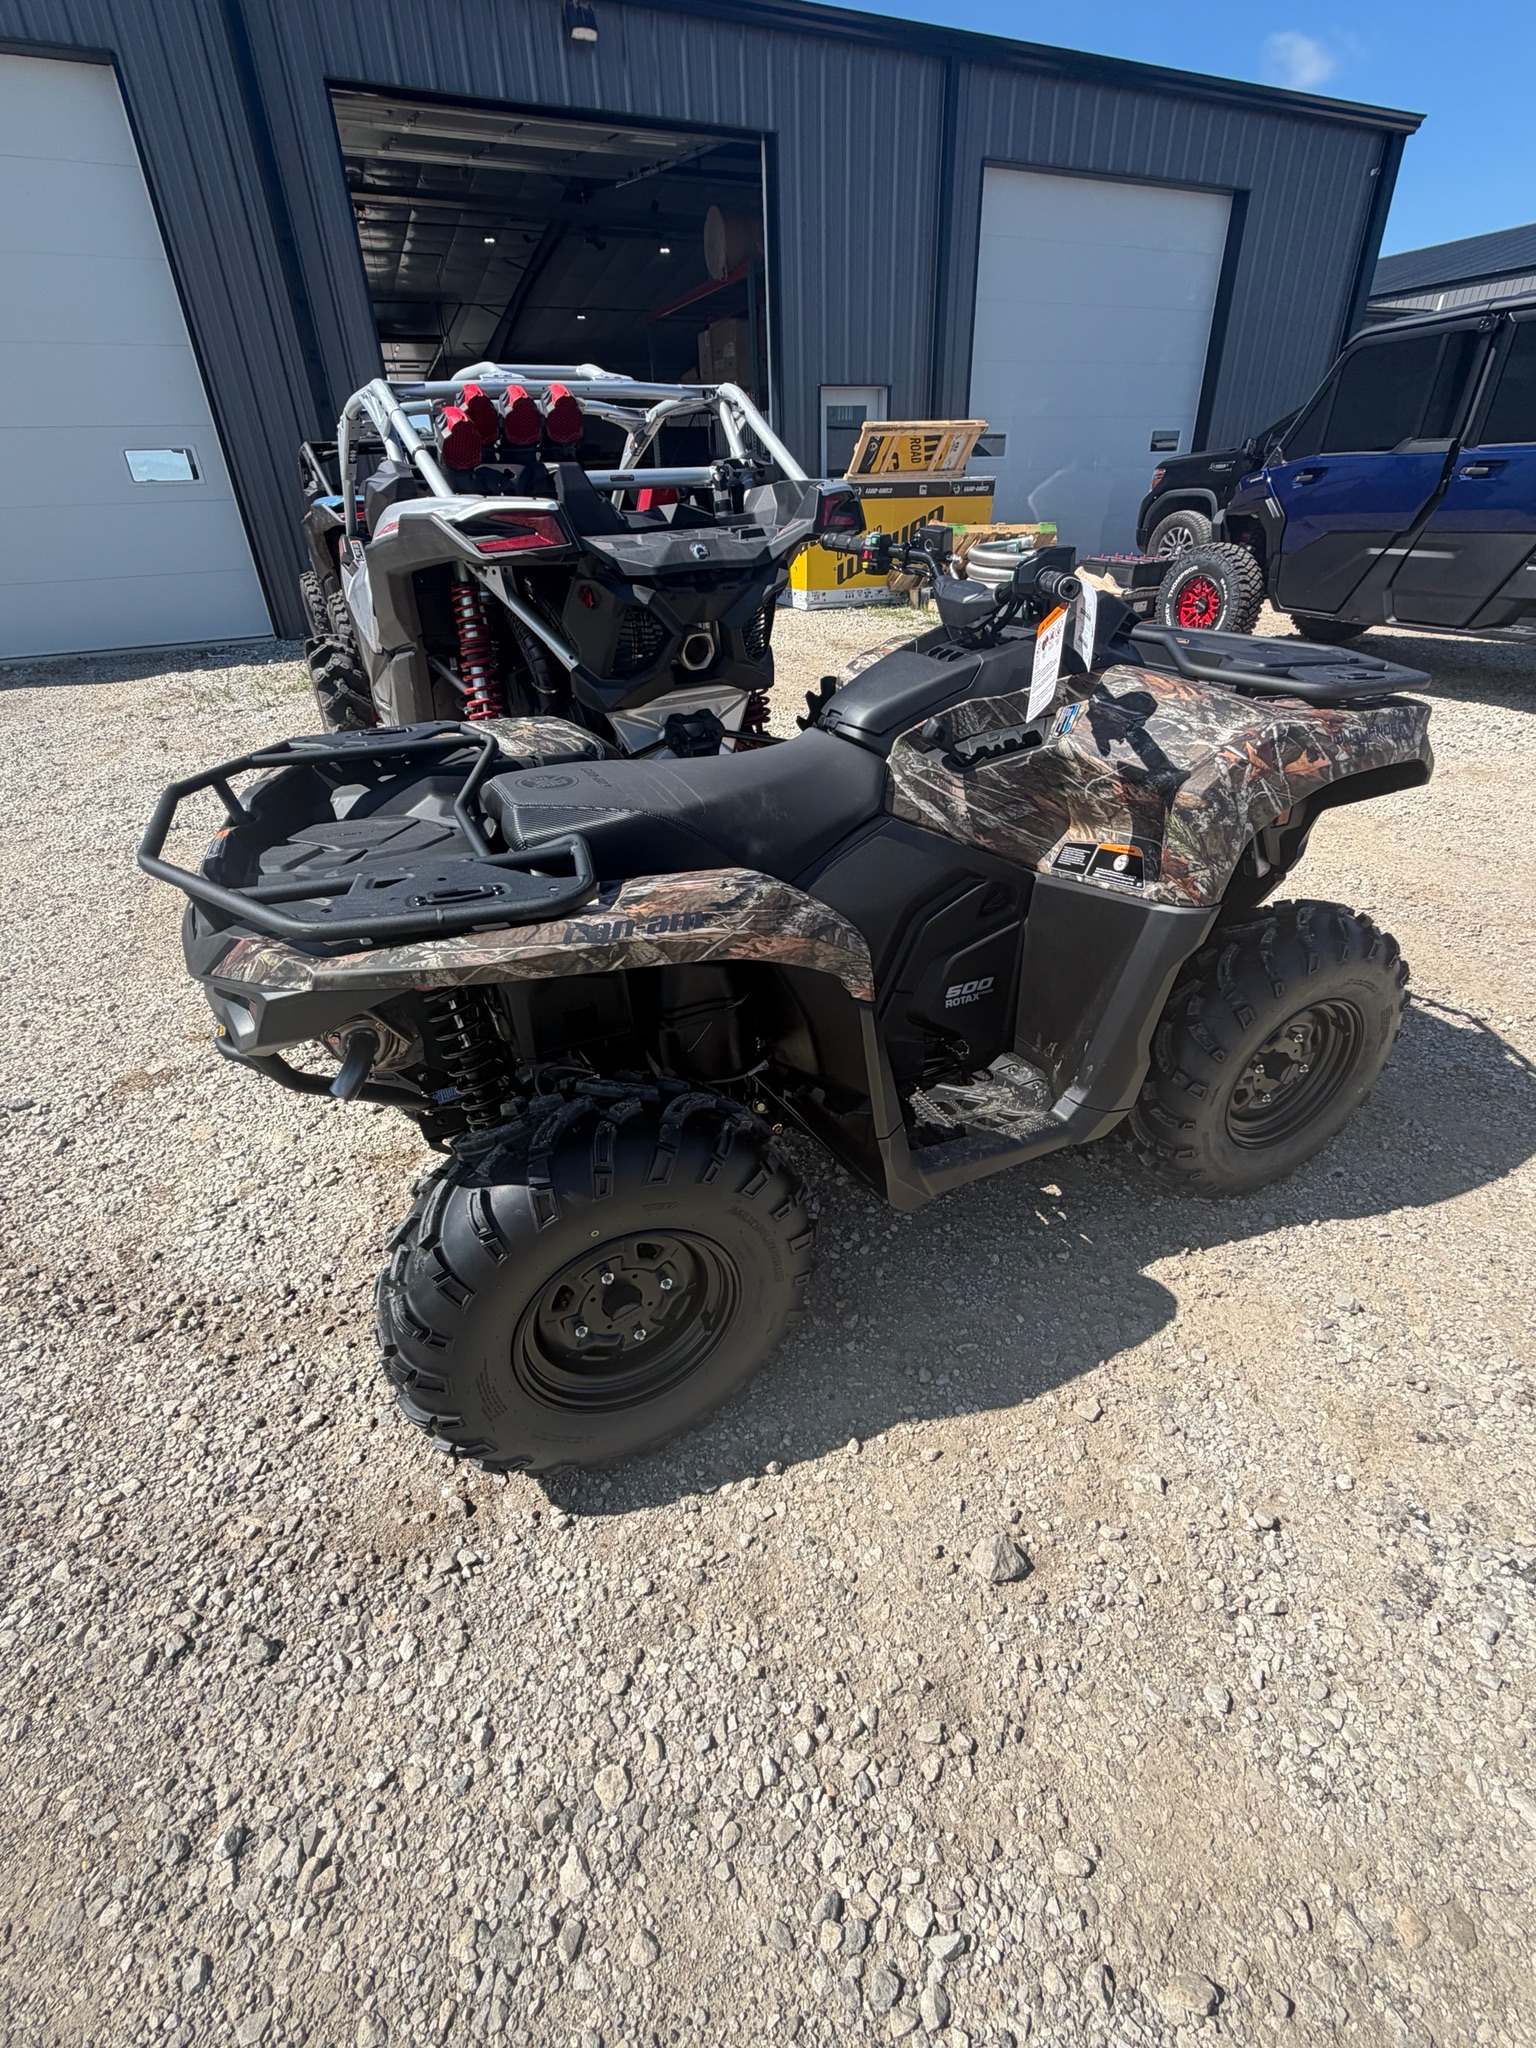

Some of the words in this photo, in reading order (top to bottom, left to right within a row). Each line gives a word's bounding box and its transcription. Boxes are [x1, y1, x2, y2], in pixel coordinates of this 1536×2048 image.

[1167, 565, 1199, 598] THOMPSON
[562, 910, 704, 945] can-am
[945, 976, 995, 999] 500
[945, 992, 980, 1009] ROTAX
